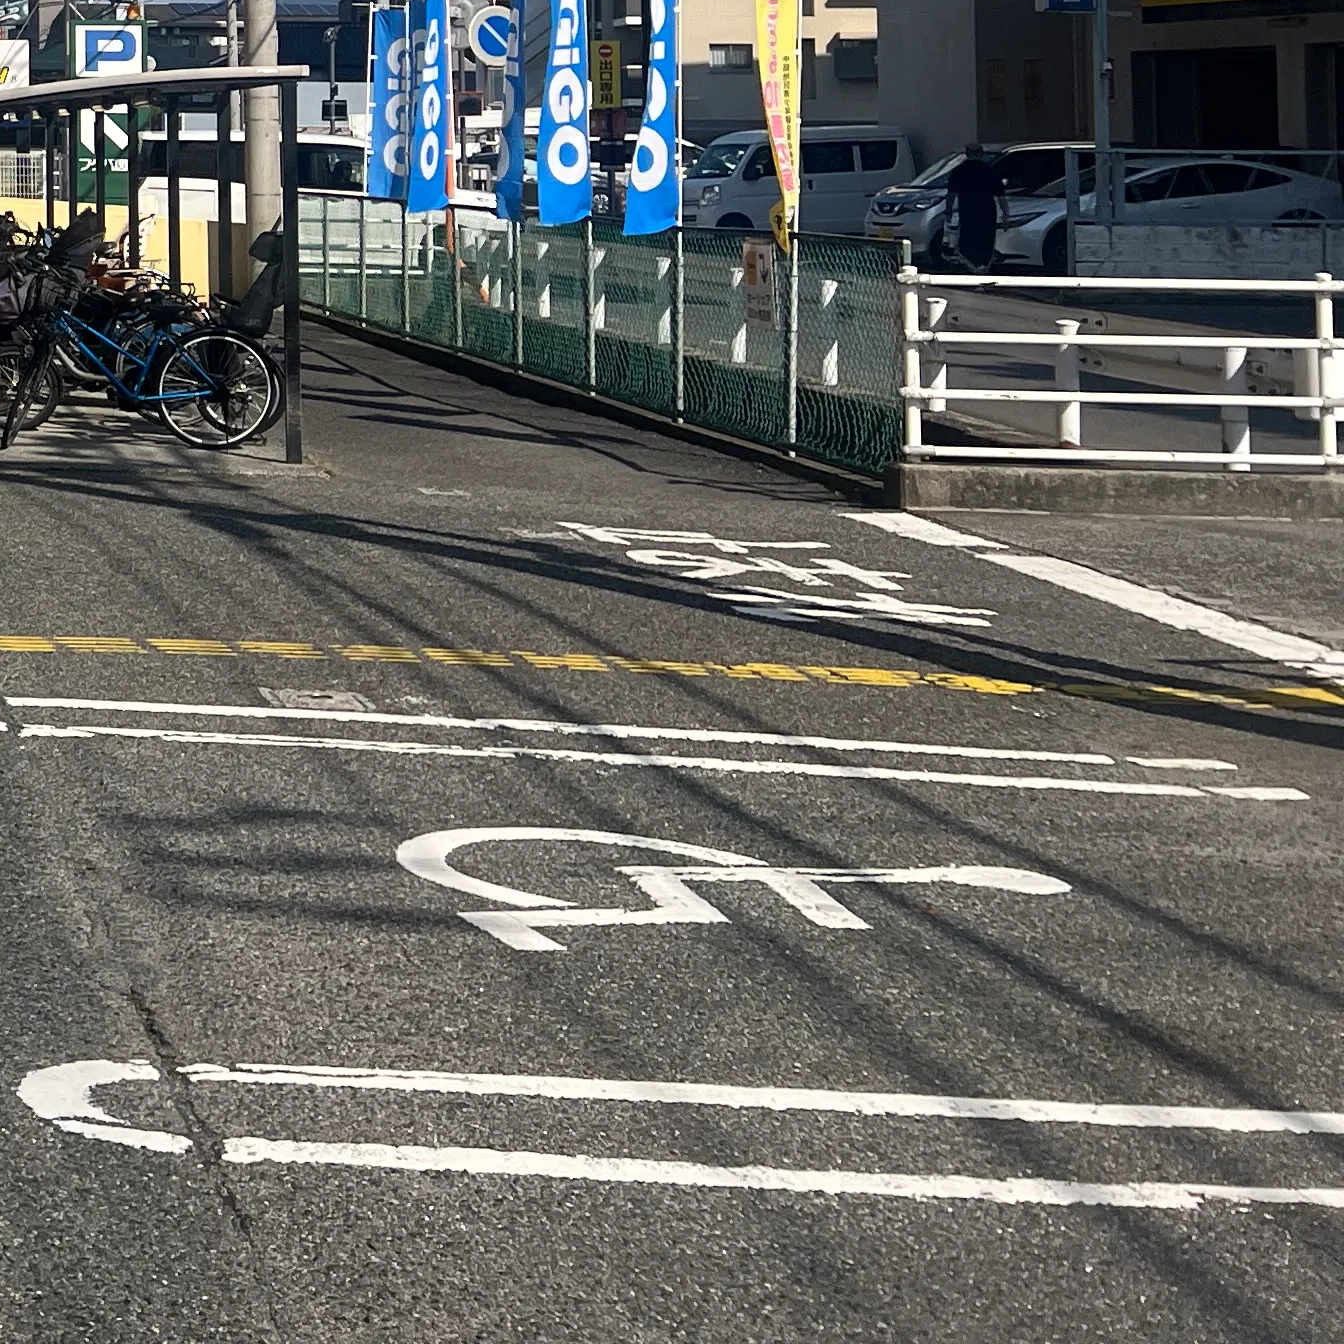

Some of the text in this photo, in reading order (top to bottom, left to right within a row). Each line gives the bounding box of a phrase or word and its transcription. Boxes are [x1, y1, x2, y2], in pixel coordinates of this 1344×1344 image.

[85, 30, 136, 71] P
[599, 59, 614, 104] 出口専用
